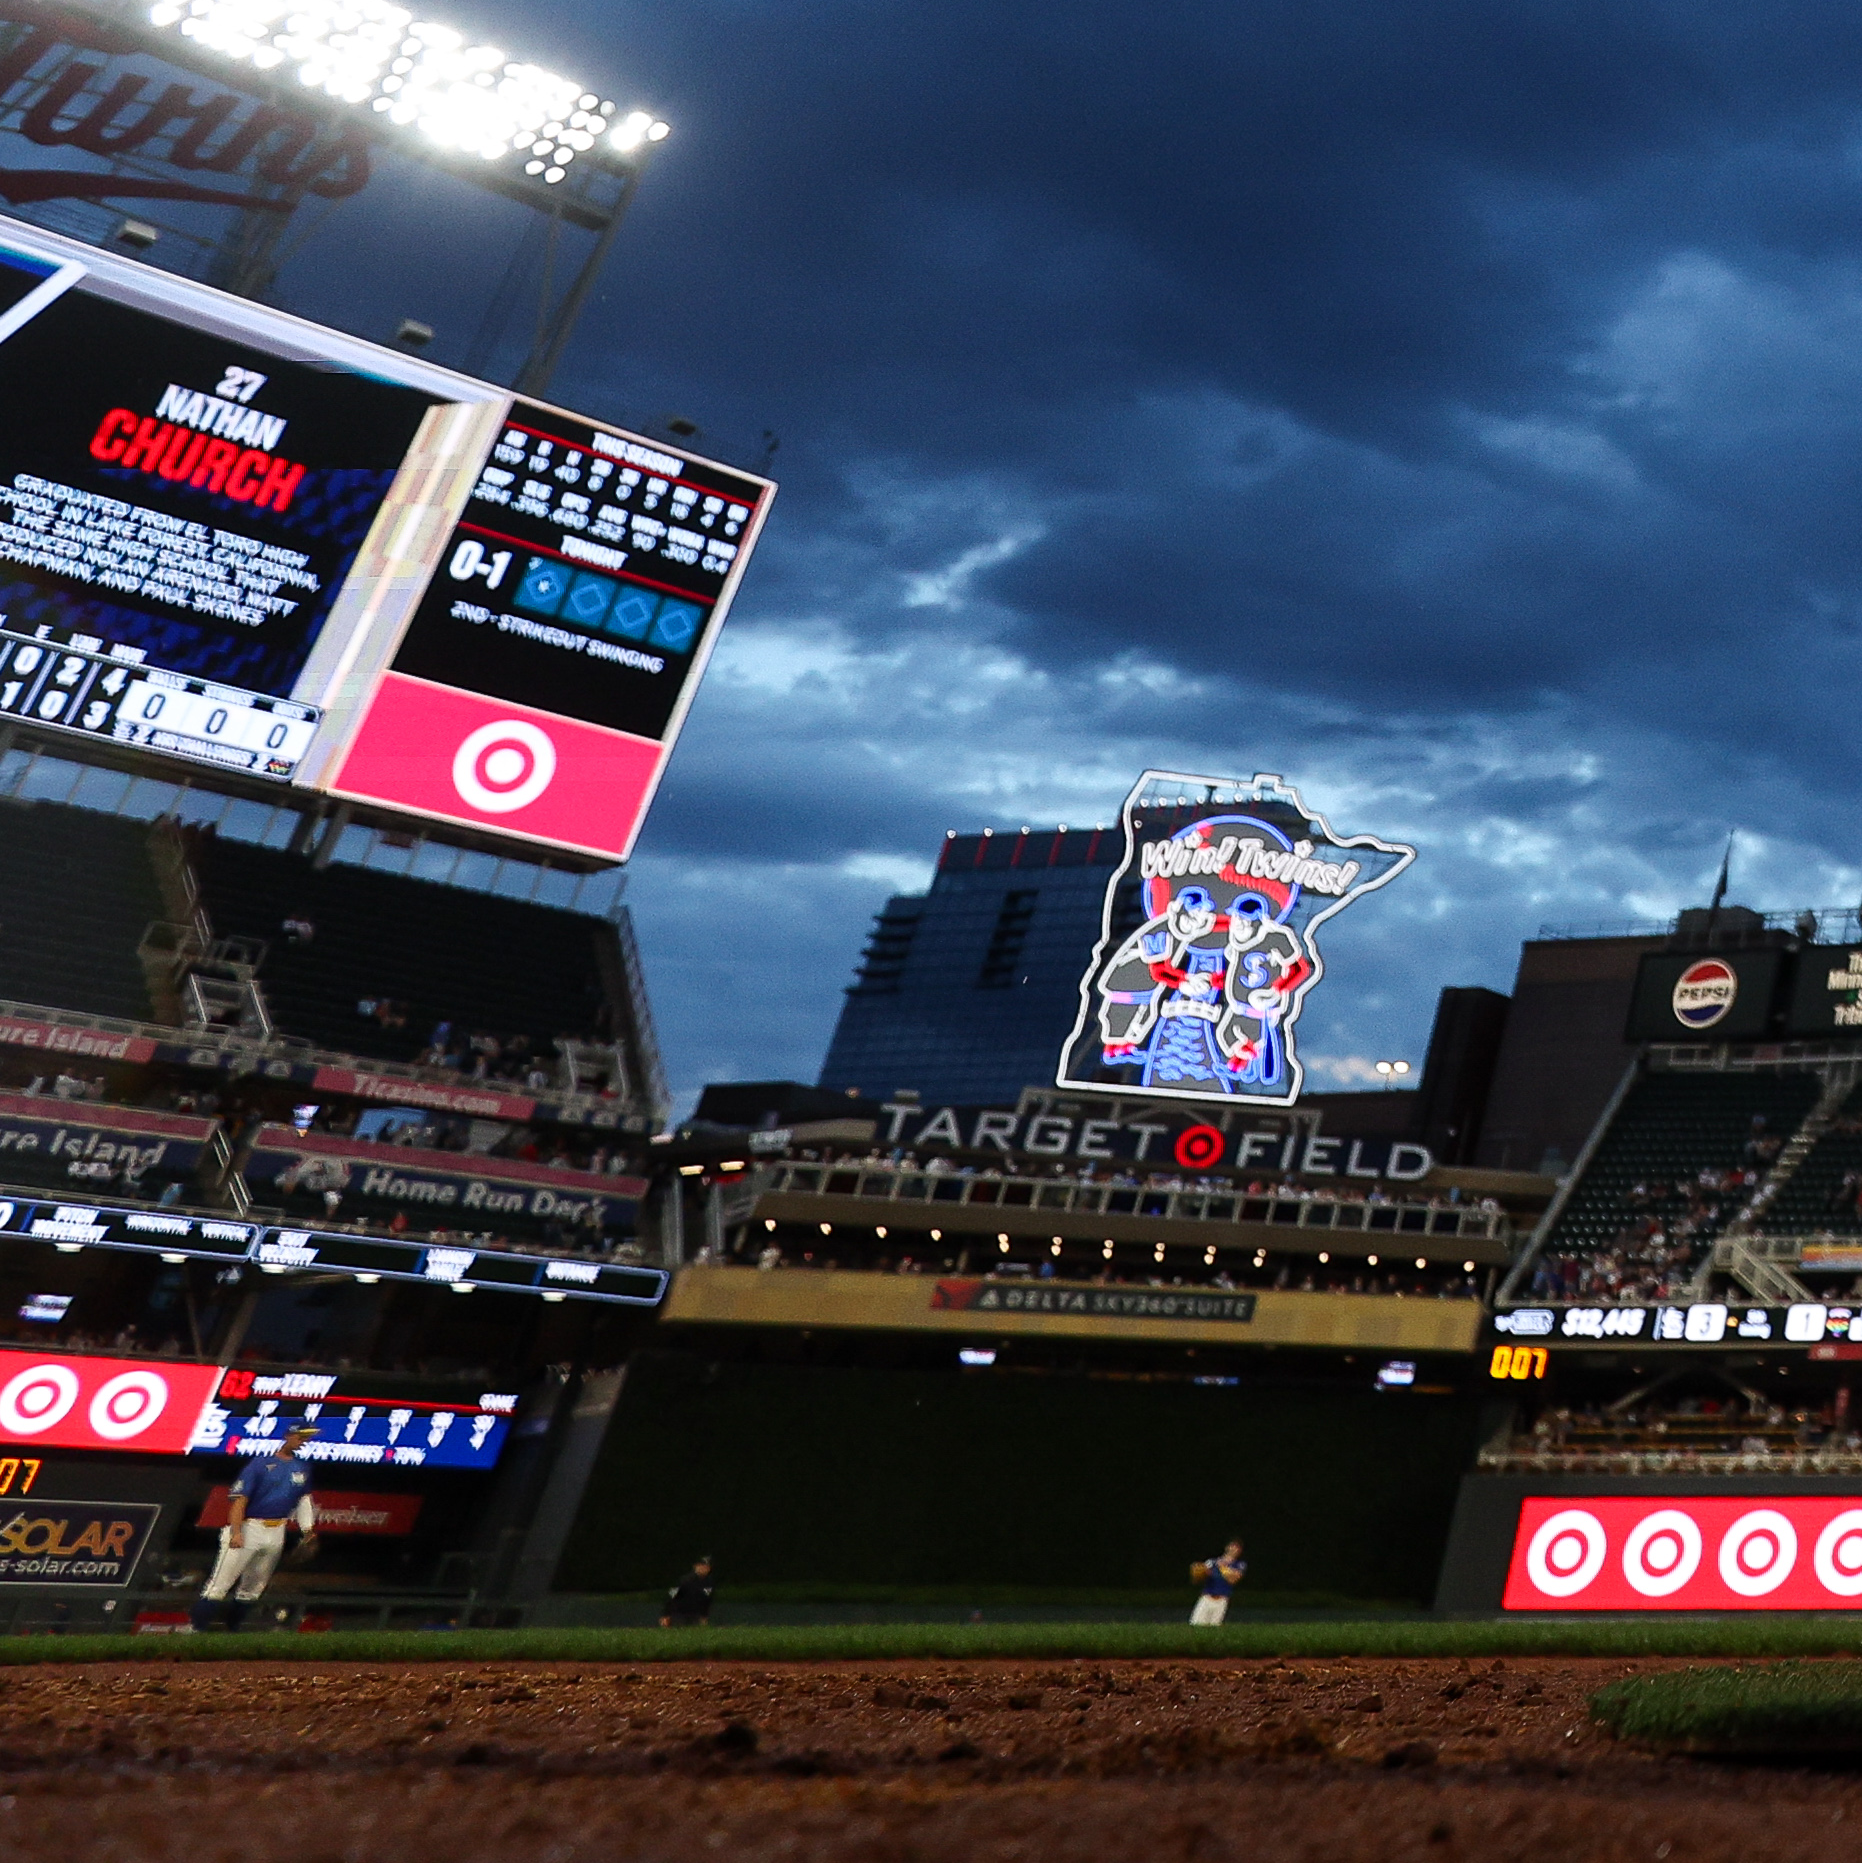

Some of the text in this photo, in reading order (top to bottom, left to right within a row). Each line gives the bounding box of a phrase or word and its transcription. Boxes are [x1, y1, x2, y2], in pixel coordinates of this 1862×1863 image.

[215, 365, 268, 403] 27
[155, 382, 287, 451] NATHAN
[90, 408, 307, 512] CHURCH
[450, 539, 513, 590] 0-1
[12, 645, 129, 696] 0 2 4
[37, 689, 69, 720] 0
[81, 700, 112, 731] 3
[143, 693, 167, 720] 0
[205, 708, 229, 735] 0
[266, 723, 289, 750] 0
[1142, 836, 1361, 897] Win! Twins!
[1678, 983, 1732, 1004] PEPSI
[45, 1029, 132, 1059] Island
[879, 1102, 1436, 1181] TARGET FIELD
[362, 1166, 458, 1201] Home
[462, 1183, 526, 1213] Run
[1490, 1345, 1549, 1380] 007
[0, 1517, 135, 1558] SOLAR
[0, 1556, 121, 1577] s-solar.com
